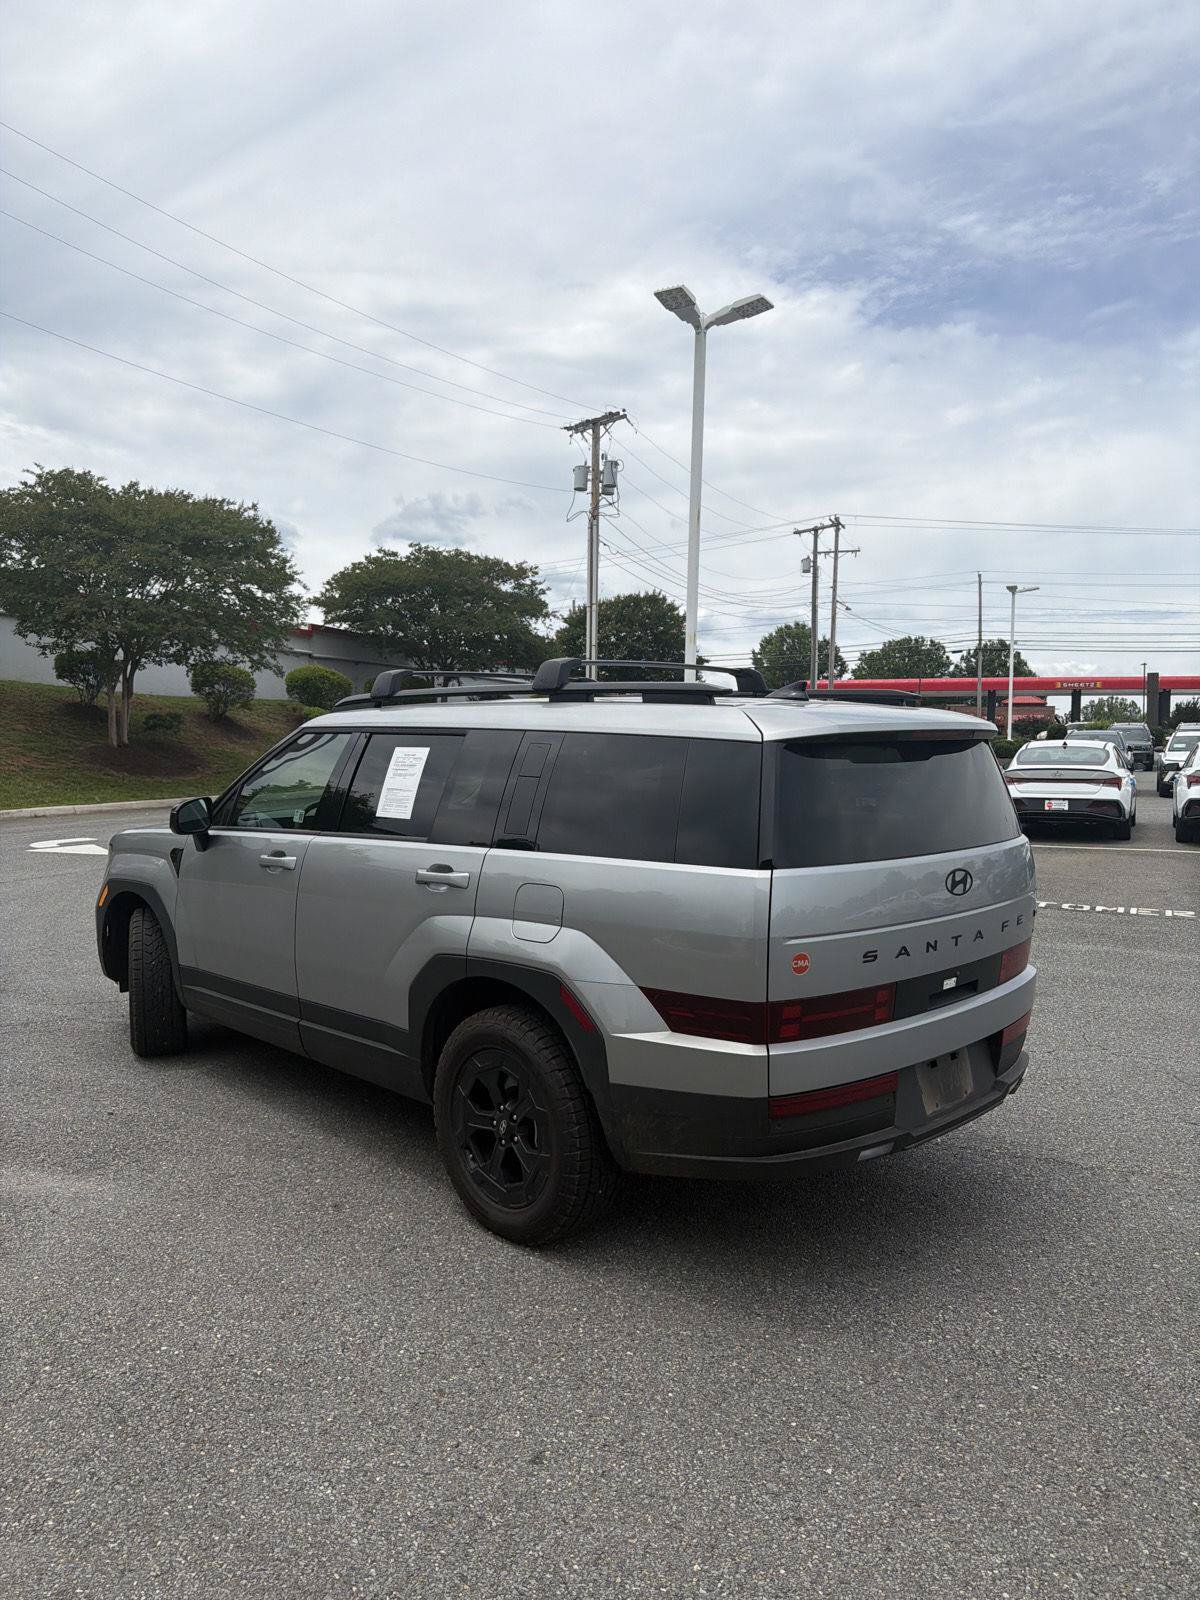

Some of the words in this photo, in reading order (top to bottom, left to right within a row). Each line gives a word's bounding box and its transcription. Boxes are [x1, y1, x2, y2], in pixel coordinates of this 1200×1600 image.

[1062, 681, 1095, 689] SHEETZ
[862, 929, 985, 964] SANTA
[1001, 914, 1024, 933] FE
[792, 959, 809, 968] CMA
